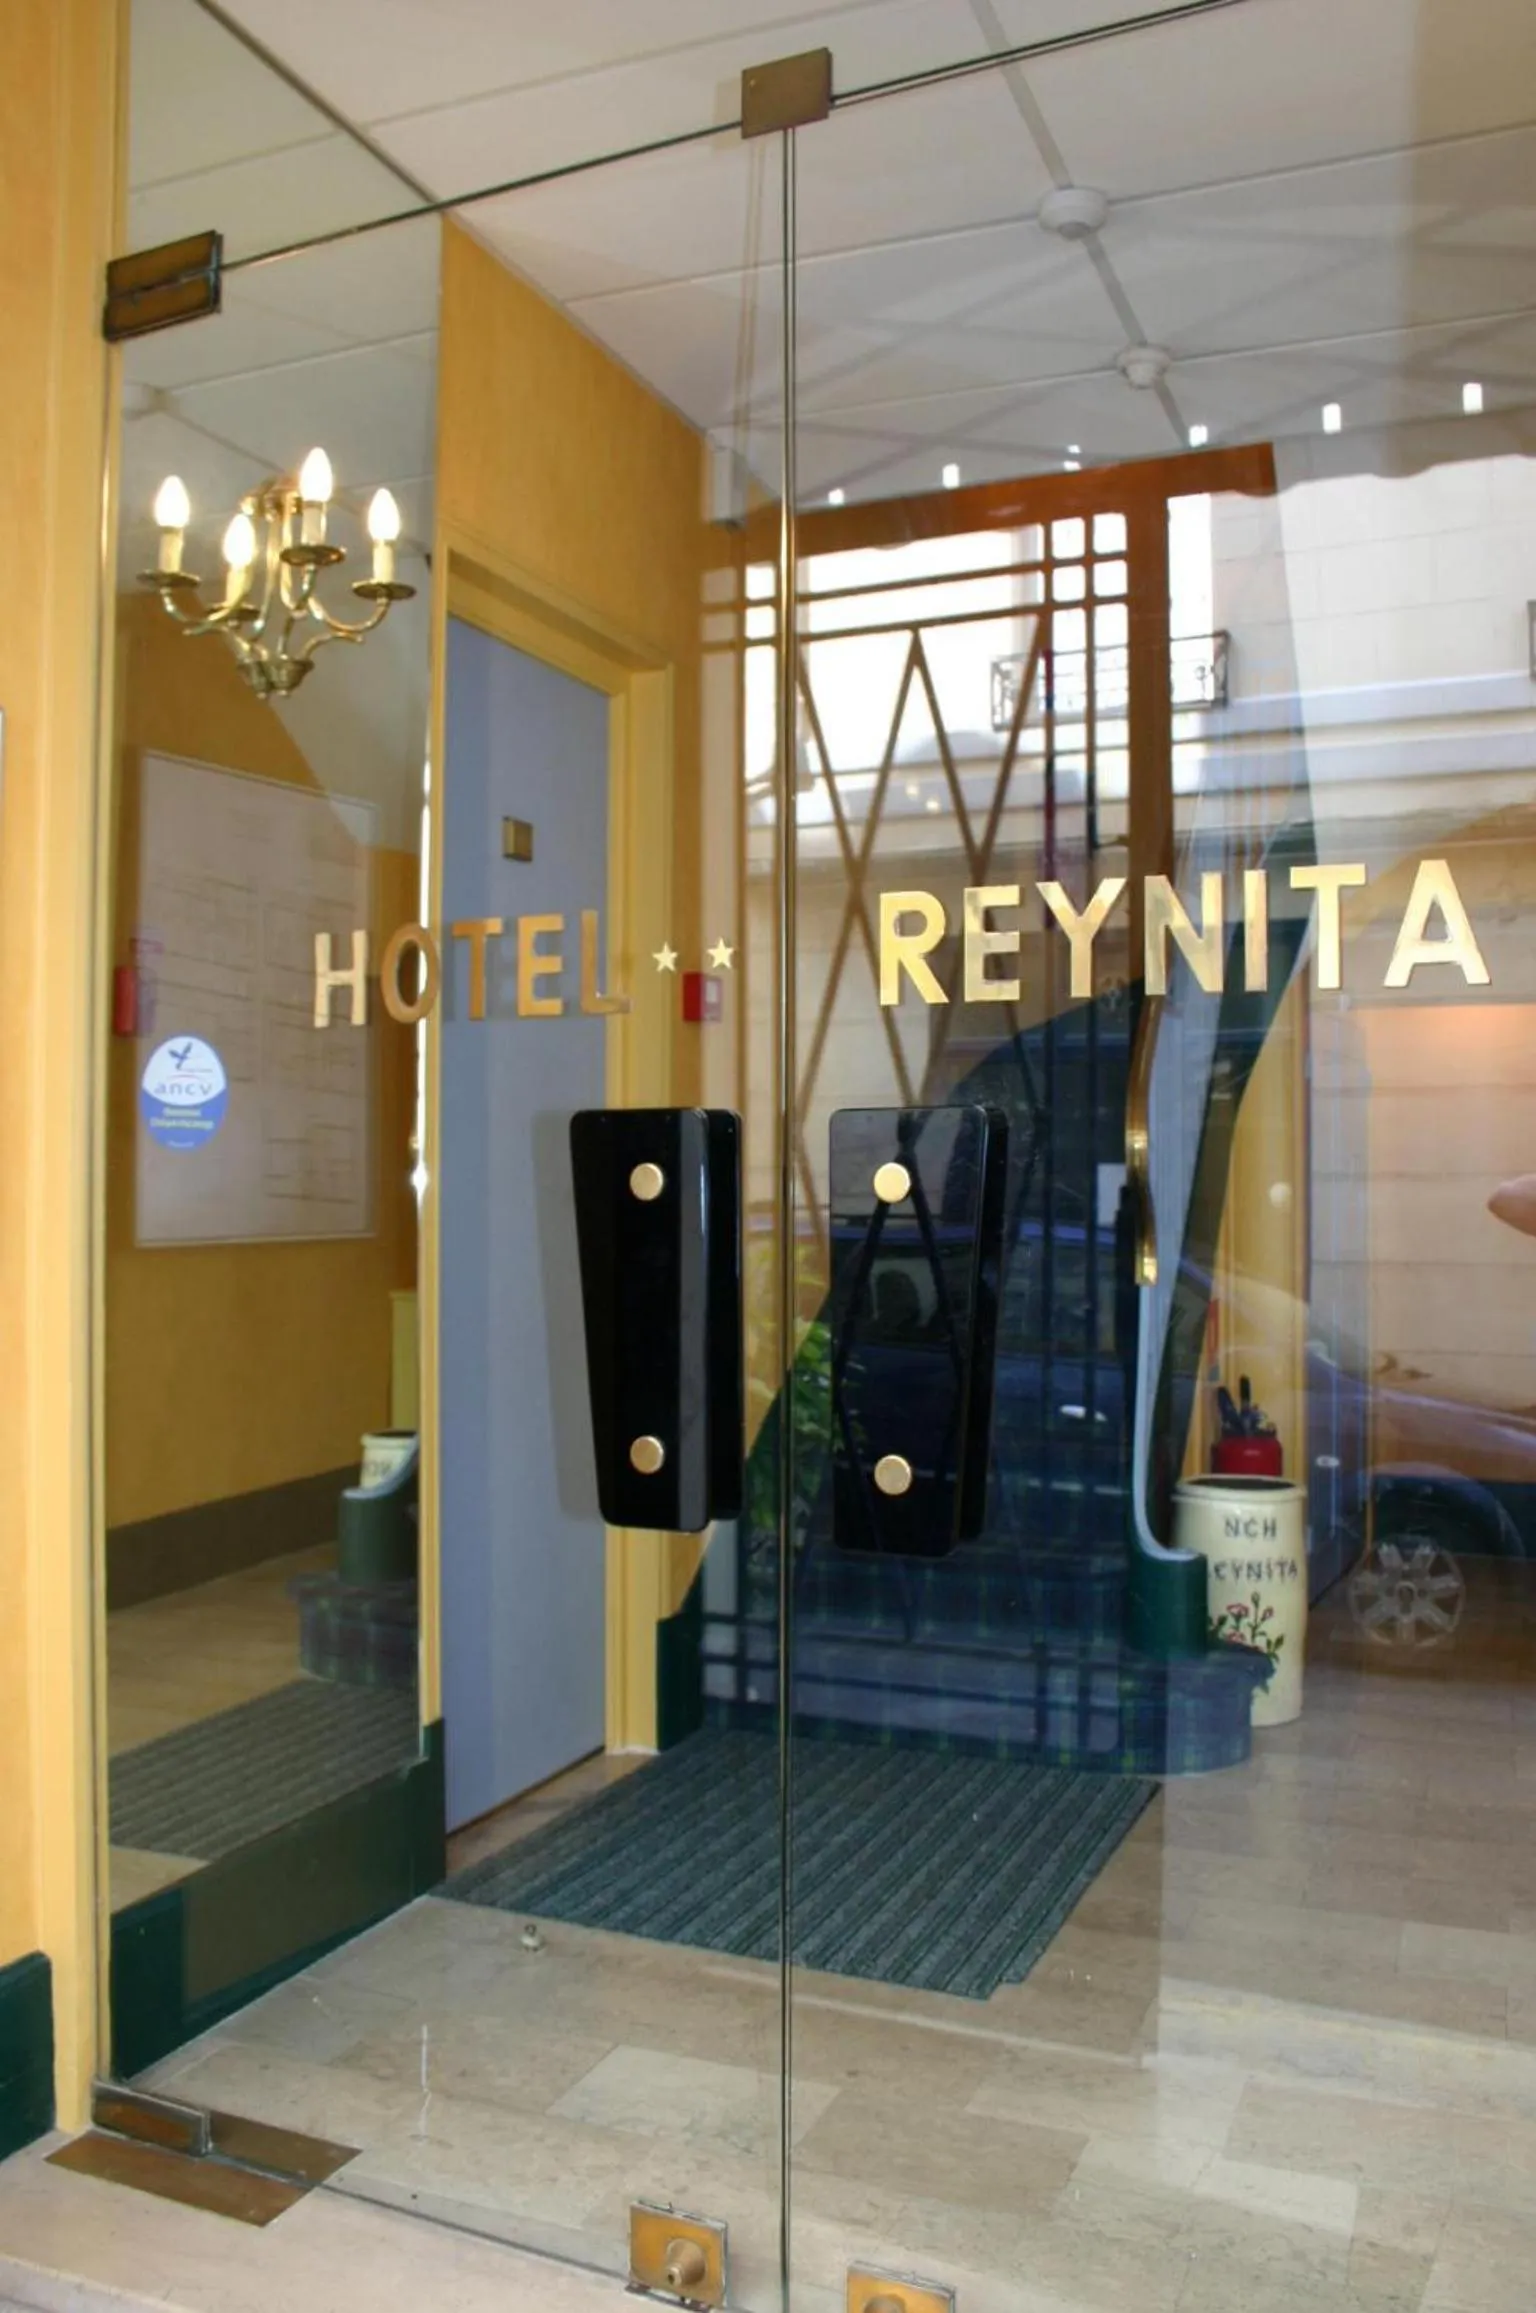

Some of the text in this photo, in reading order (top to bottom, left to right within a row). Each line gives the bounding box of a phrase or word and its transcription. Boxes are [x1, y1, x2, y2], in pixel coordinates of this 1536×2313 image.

[313, 909, 631, 1028] HOTEL
[879, 858, 1492, 1007] REYNITA
[153, 1081, 214, 1097] ancv
[1208, 1557, 1298, 1583] EYNITA
